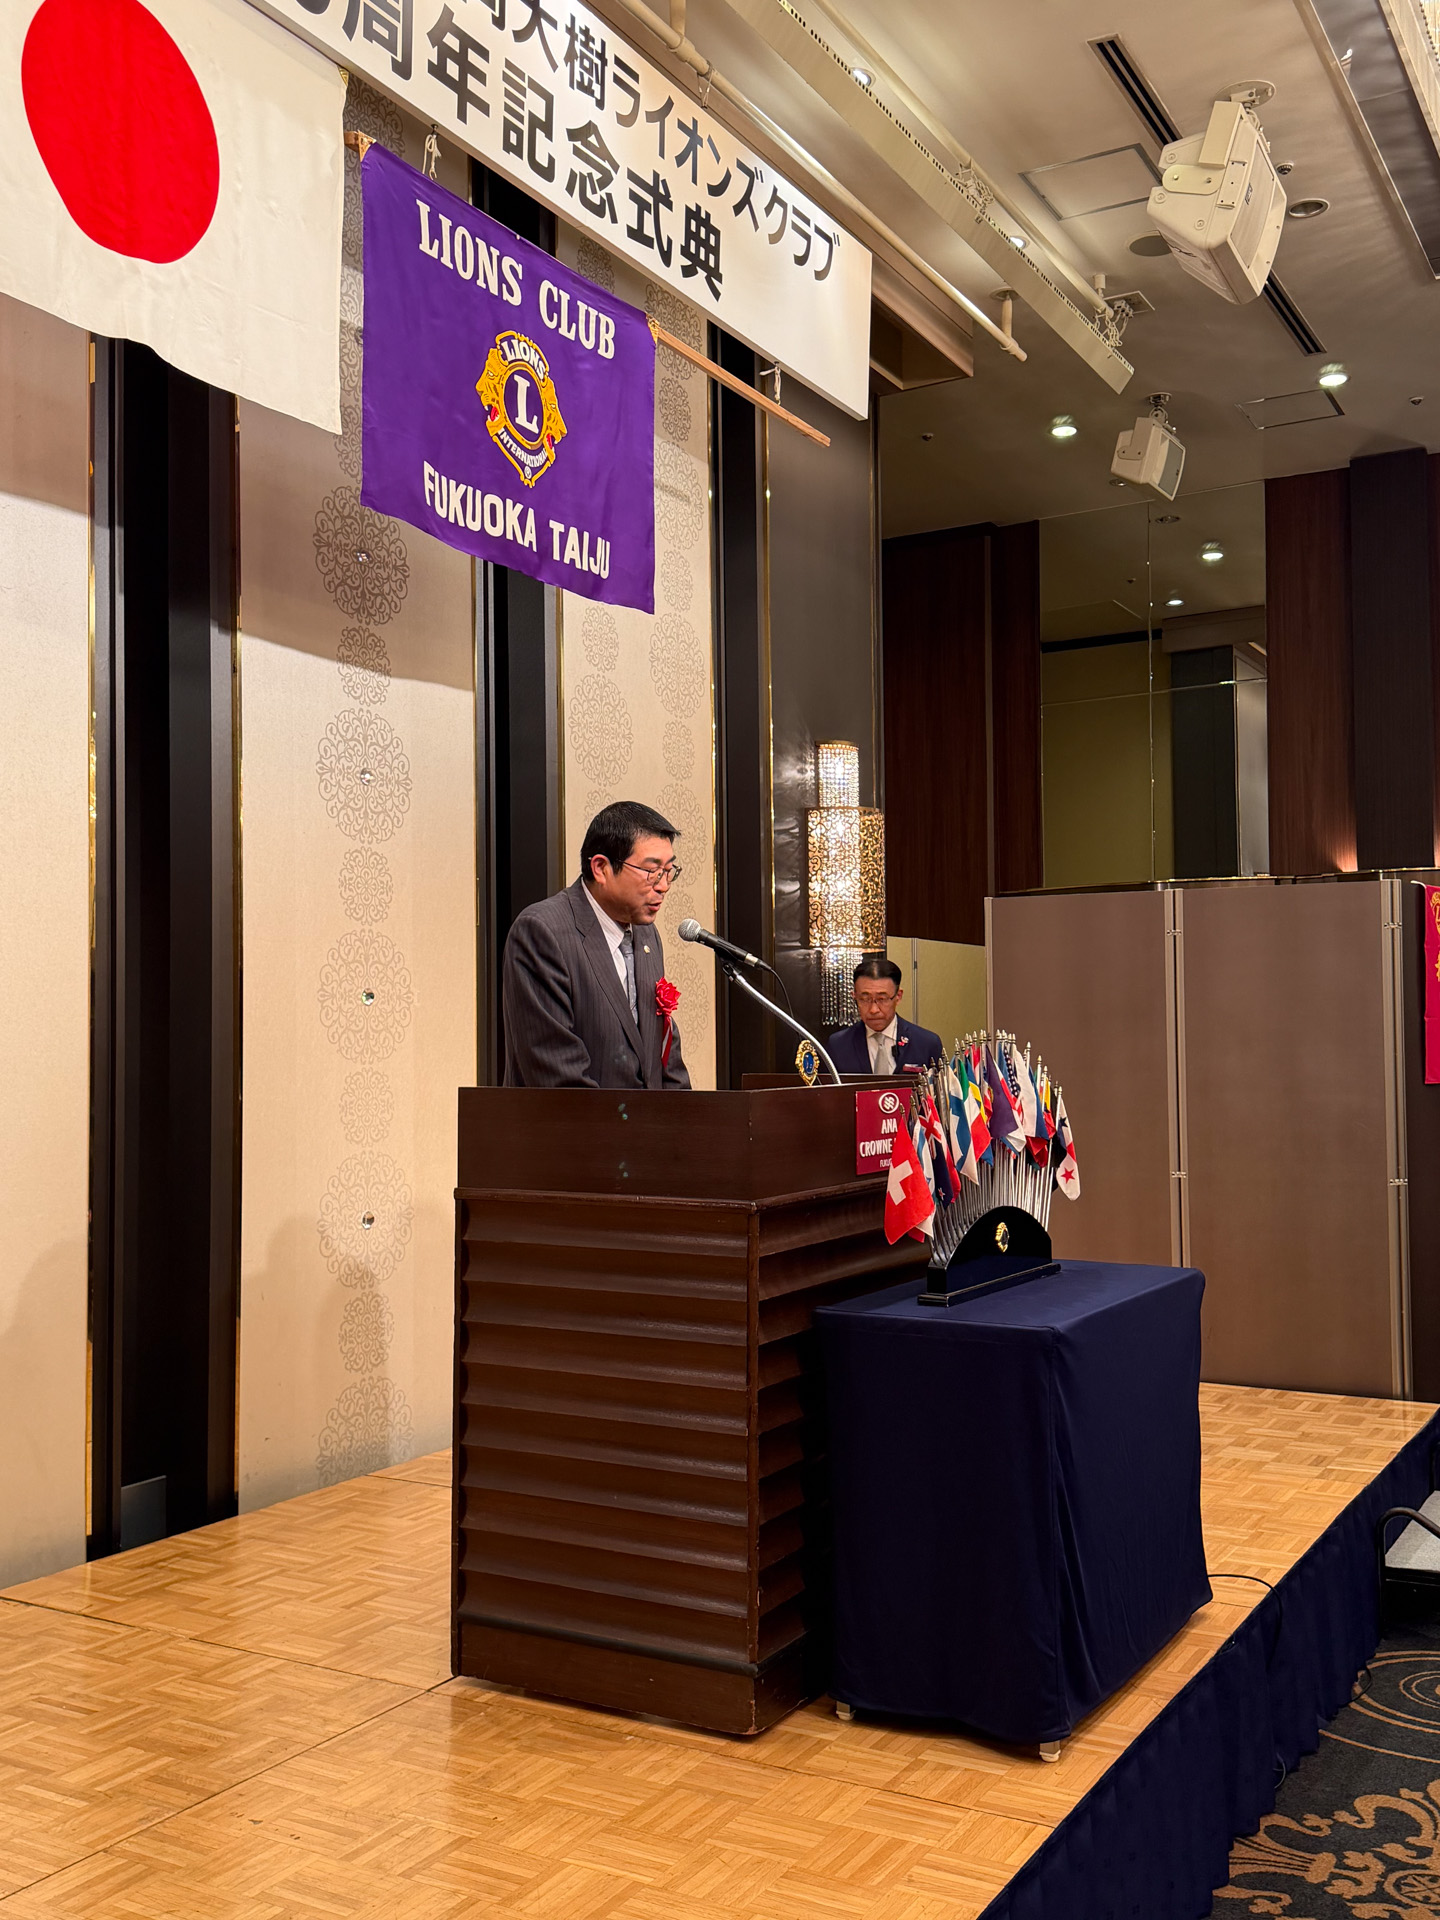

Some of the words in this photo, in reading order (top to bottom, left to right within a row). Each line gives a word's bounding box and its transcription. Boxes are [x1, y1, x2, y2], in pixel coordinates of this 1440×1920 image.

[296, 0, 723, 302] 周年記念式典
[415, 198, 524, 307] LIONS
[539, 279, 616, 360] CLUB
[501, 338, 546, 381] LIONS
[513, 374, 539, 434] L
[422, 460, 538, 553] FUKUOKA
[549, 519, 611, 580] TAIJU
[860, 1139, 892, 1157] CROWNE
[882, 1118, 897, 1134] ANA
